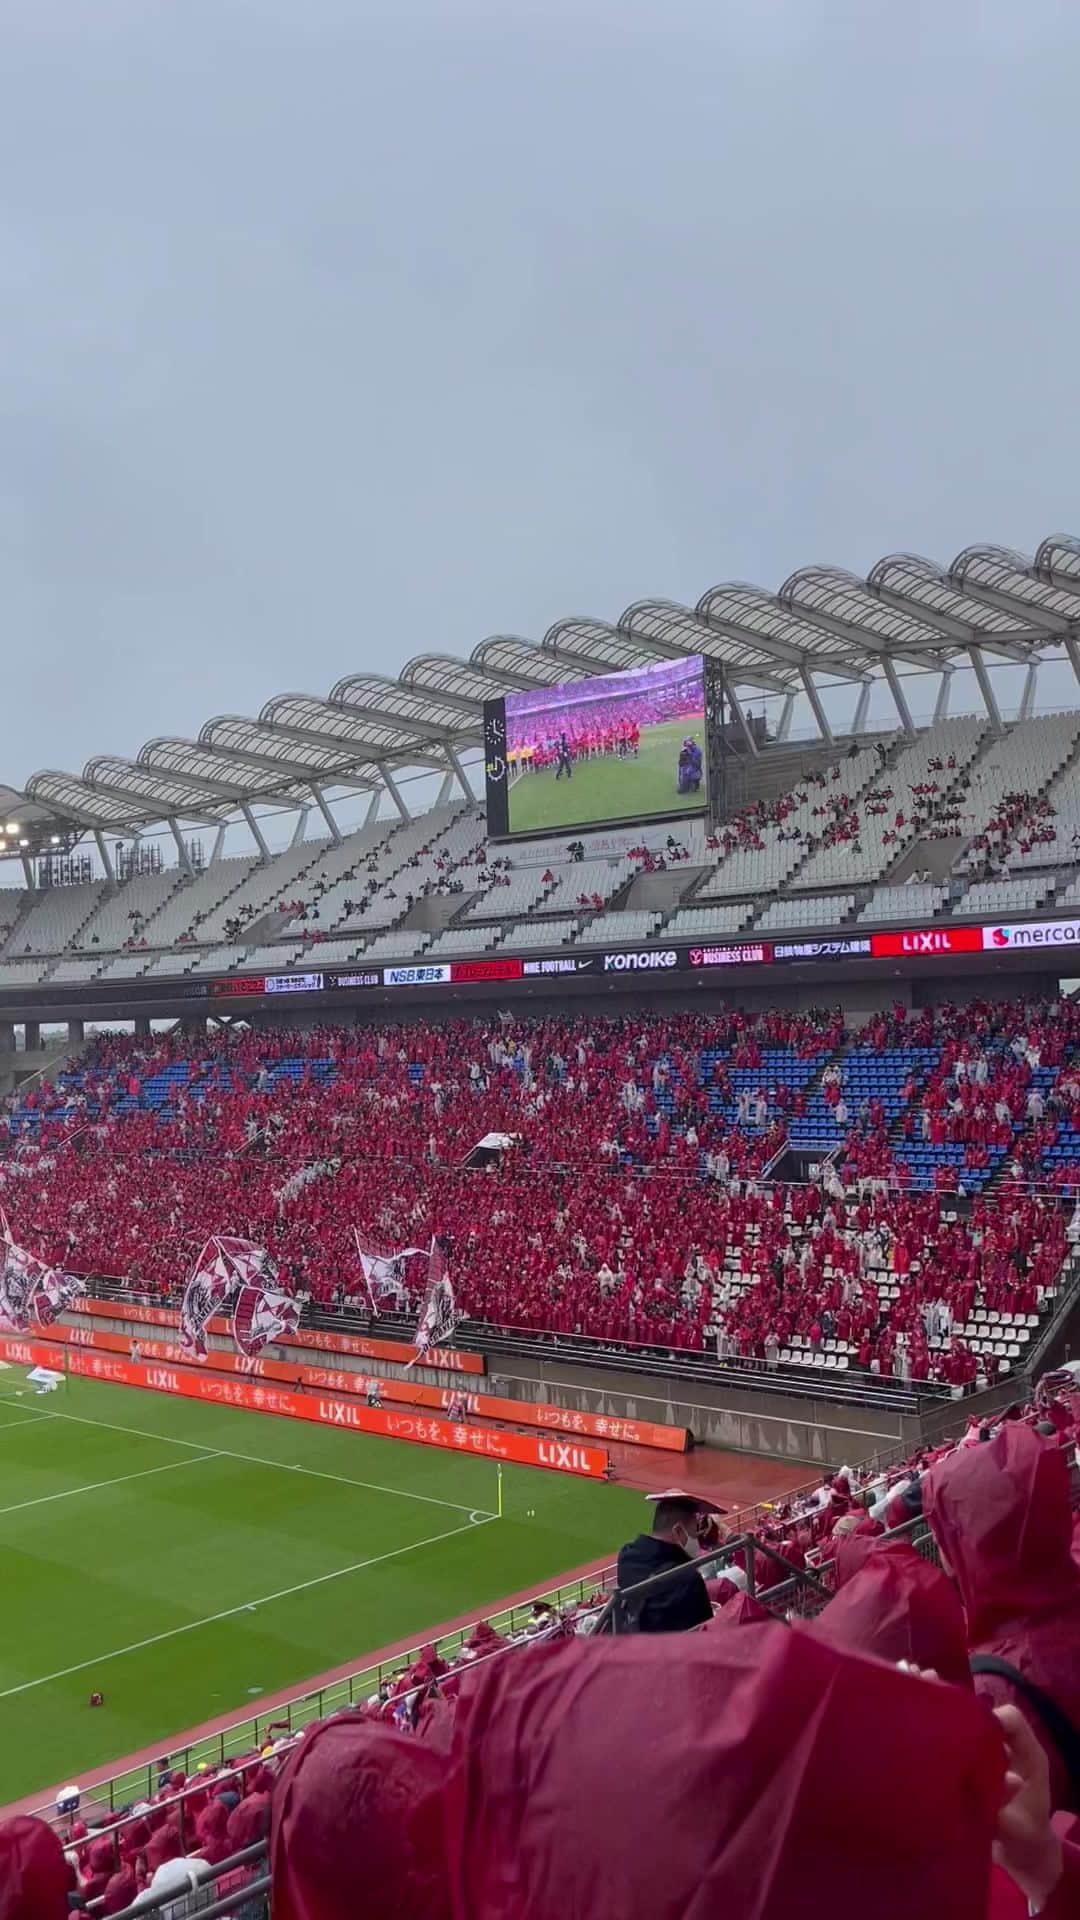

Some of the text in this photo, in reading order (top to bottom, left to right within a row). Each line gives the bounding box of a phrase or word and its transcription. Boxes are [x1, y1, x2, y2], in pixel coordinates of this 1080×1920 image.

[903, 932, 951, 951] LIXIL
[70, 1328, 95, 1344] LIXIL
[5, 1343, 33, 1361] LIXIL
[425, 1350, 464, 1369] LIXIL
[146, 1369, 180, 1389] LIXIL
[319, 1402, 361, 1425] LIXIL
[537, 1408, 641, 1442] いつもを、幸せに。
[386, 1415, 508, 1457] いつもを、幸せに。
[538, 1443, 592, 1471] LIXIL
